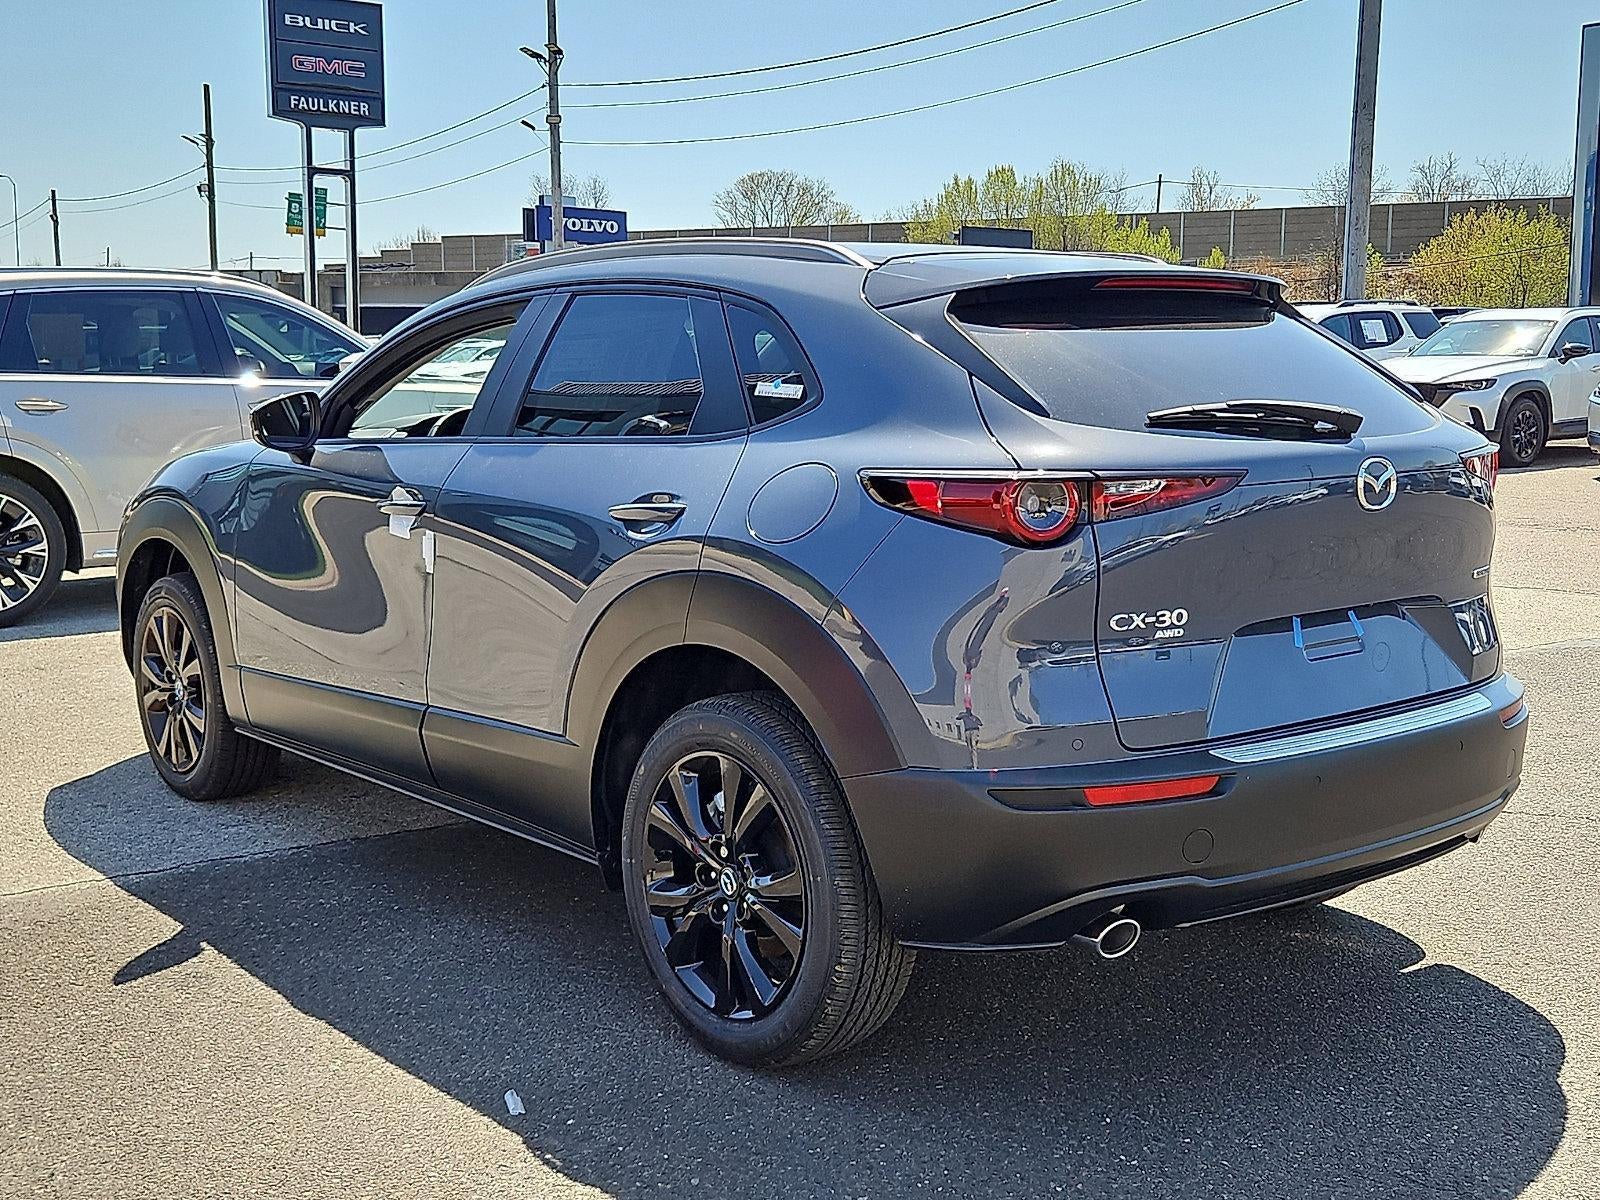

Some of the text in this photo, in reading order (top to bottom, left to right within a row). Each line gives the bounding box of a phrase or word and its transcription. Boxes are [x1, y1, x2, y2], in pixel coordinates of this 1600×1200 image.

[284, 13, 370, 36] BUICK
[292, 54, 366, 78] GMC
[290, 95, 370, 116] FAULKNER
[1109, 608, 1188, 631] CX-30
[1154, 628, 1185, 639] AWD
